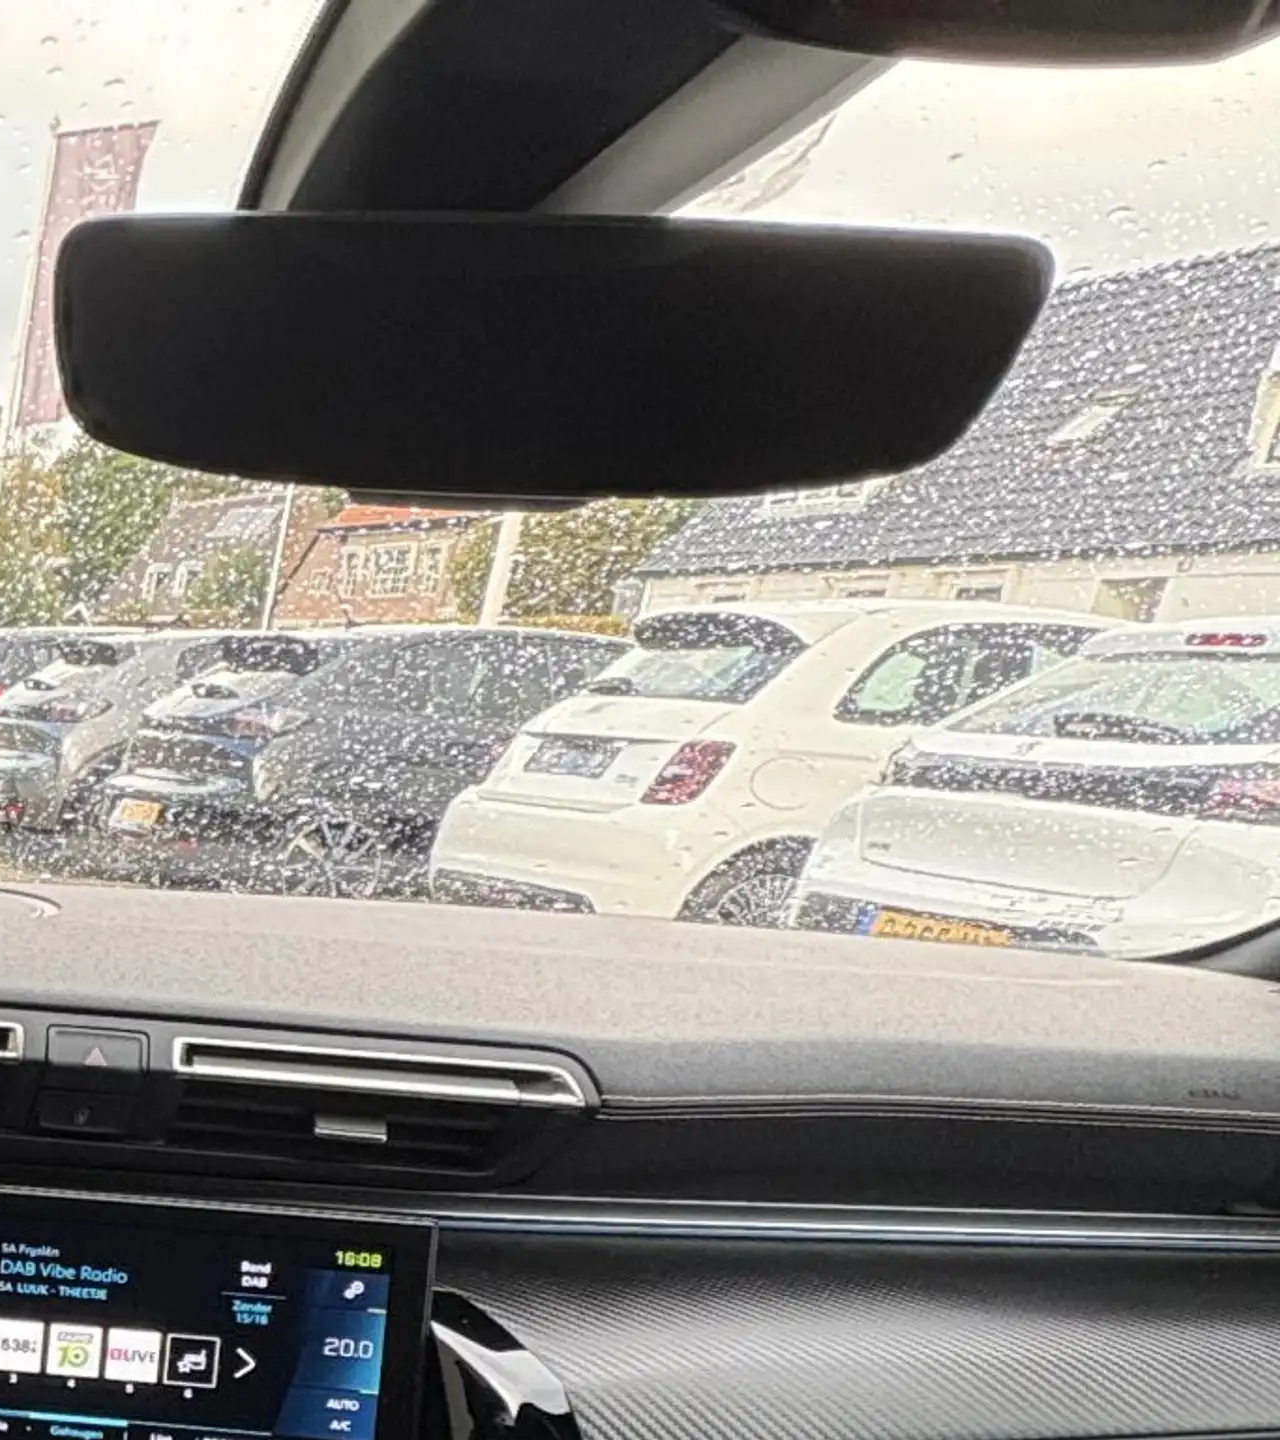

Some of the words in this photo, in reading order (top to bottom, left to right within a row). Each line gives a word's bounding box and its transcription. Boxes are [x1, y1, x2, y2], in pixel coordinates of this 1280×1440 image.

[0, 1259, 36, 1276] DAB
[40, 1262, 76, 1280] Vibe
[80, 1264, 129, 1284] Radio
[323, 1337, 374, 1359] 20.0
